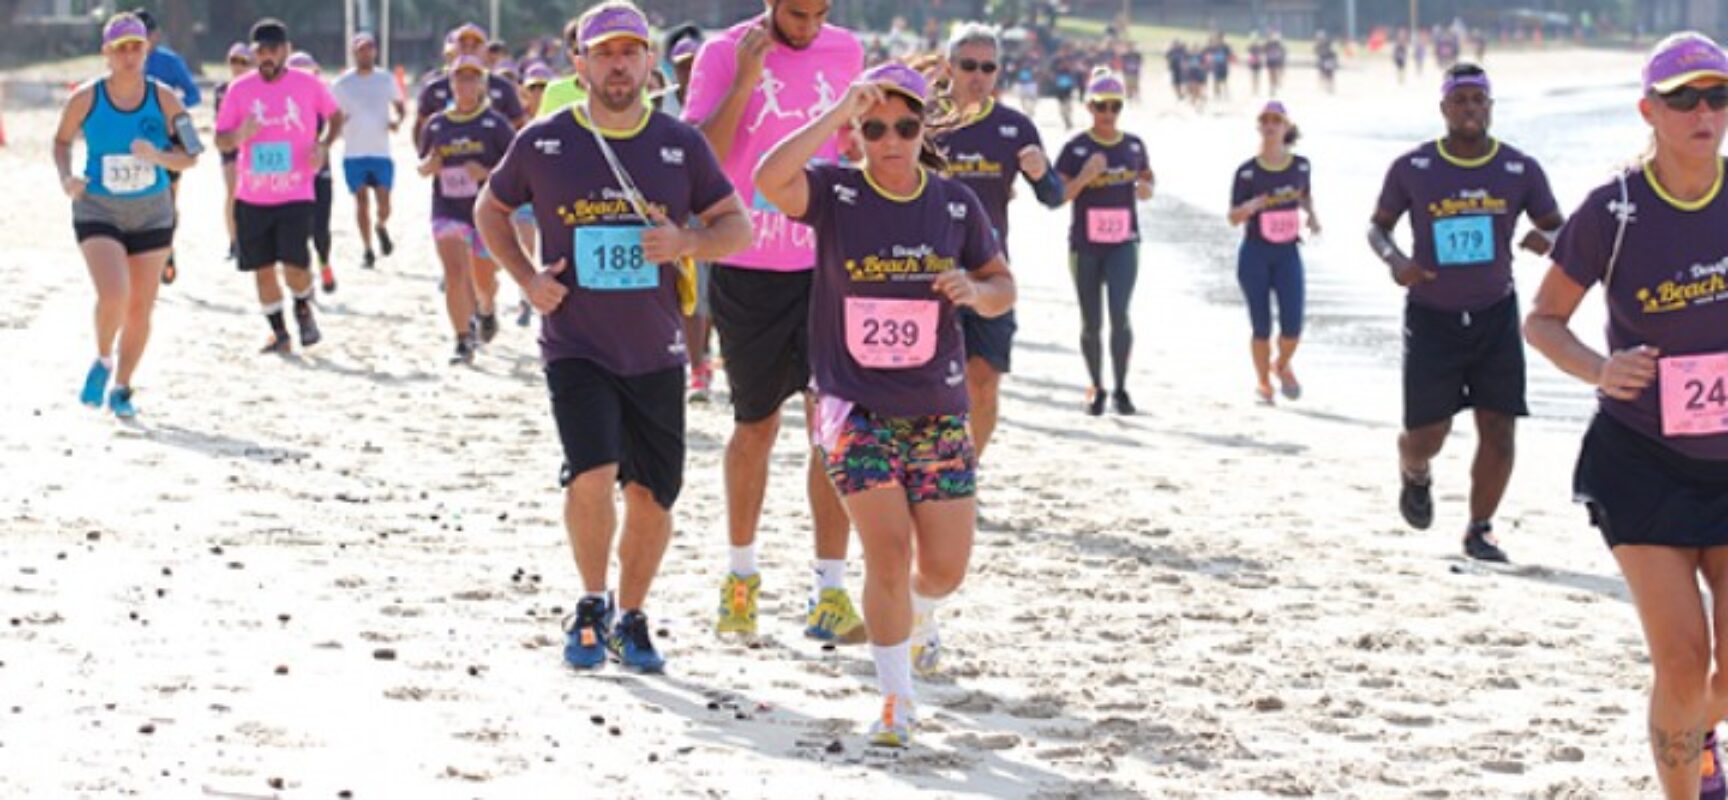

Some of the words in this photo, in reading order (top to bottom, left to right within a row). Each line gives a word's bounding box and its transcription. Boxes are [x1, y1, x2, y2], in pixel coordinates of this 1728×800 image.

[1449, 230, 1484, 250] 179
[593, 244, 644, 270] 188
[863, 255, 919, 273] Beach
[1657, 272, 1726, 302] Beach
[863, 318, 919, 347] 239
[1684, 376, 1728, 411] 24
